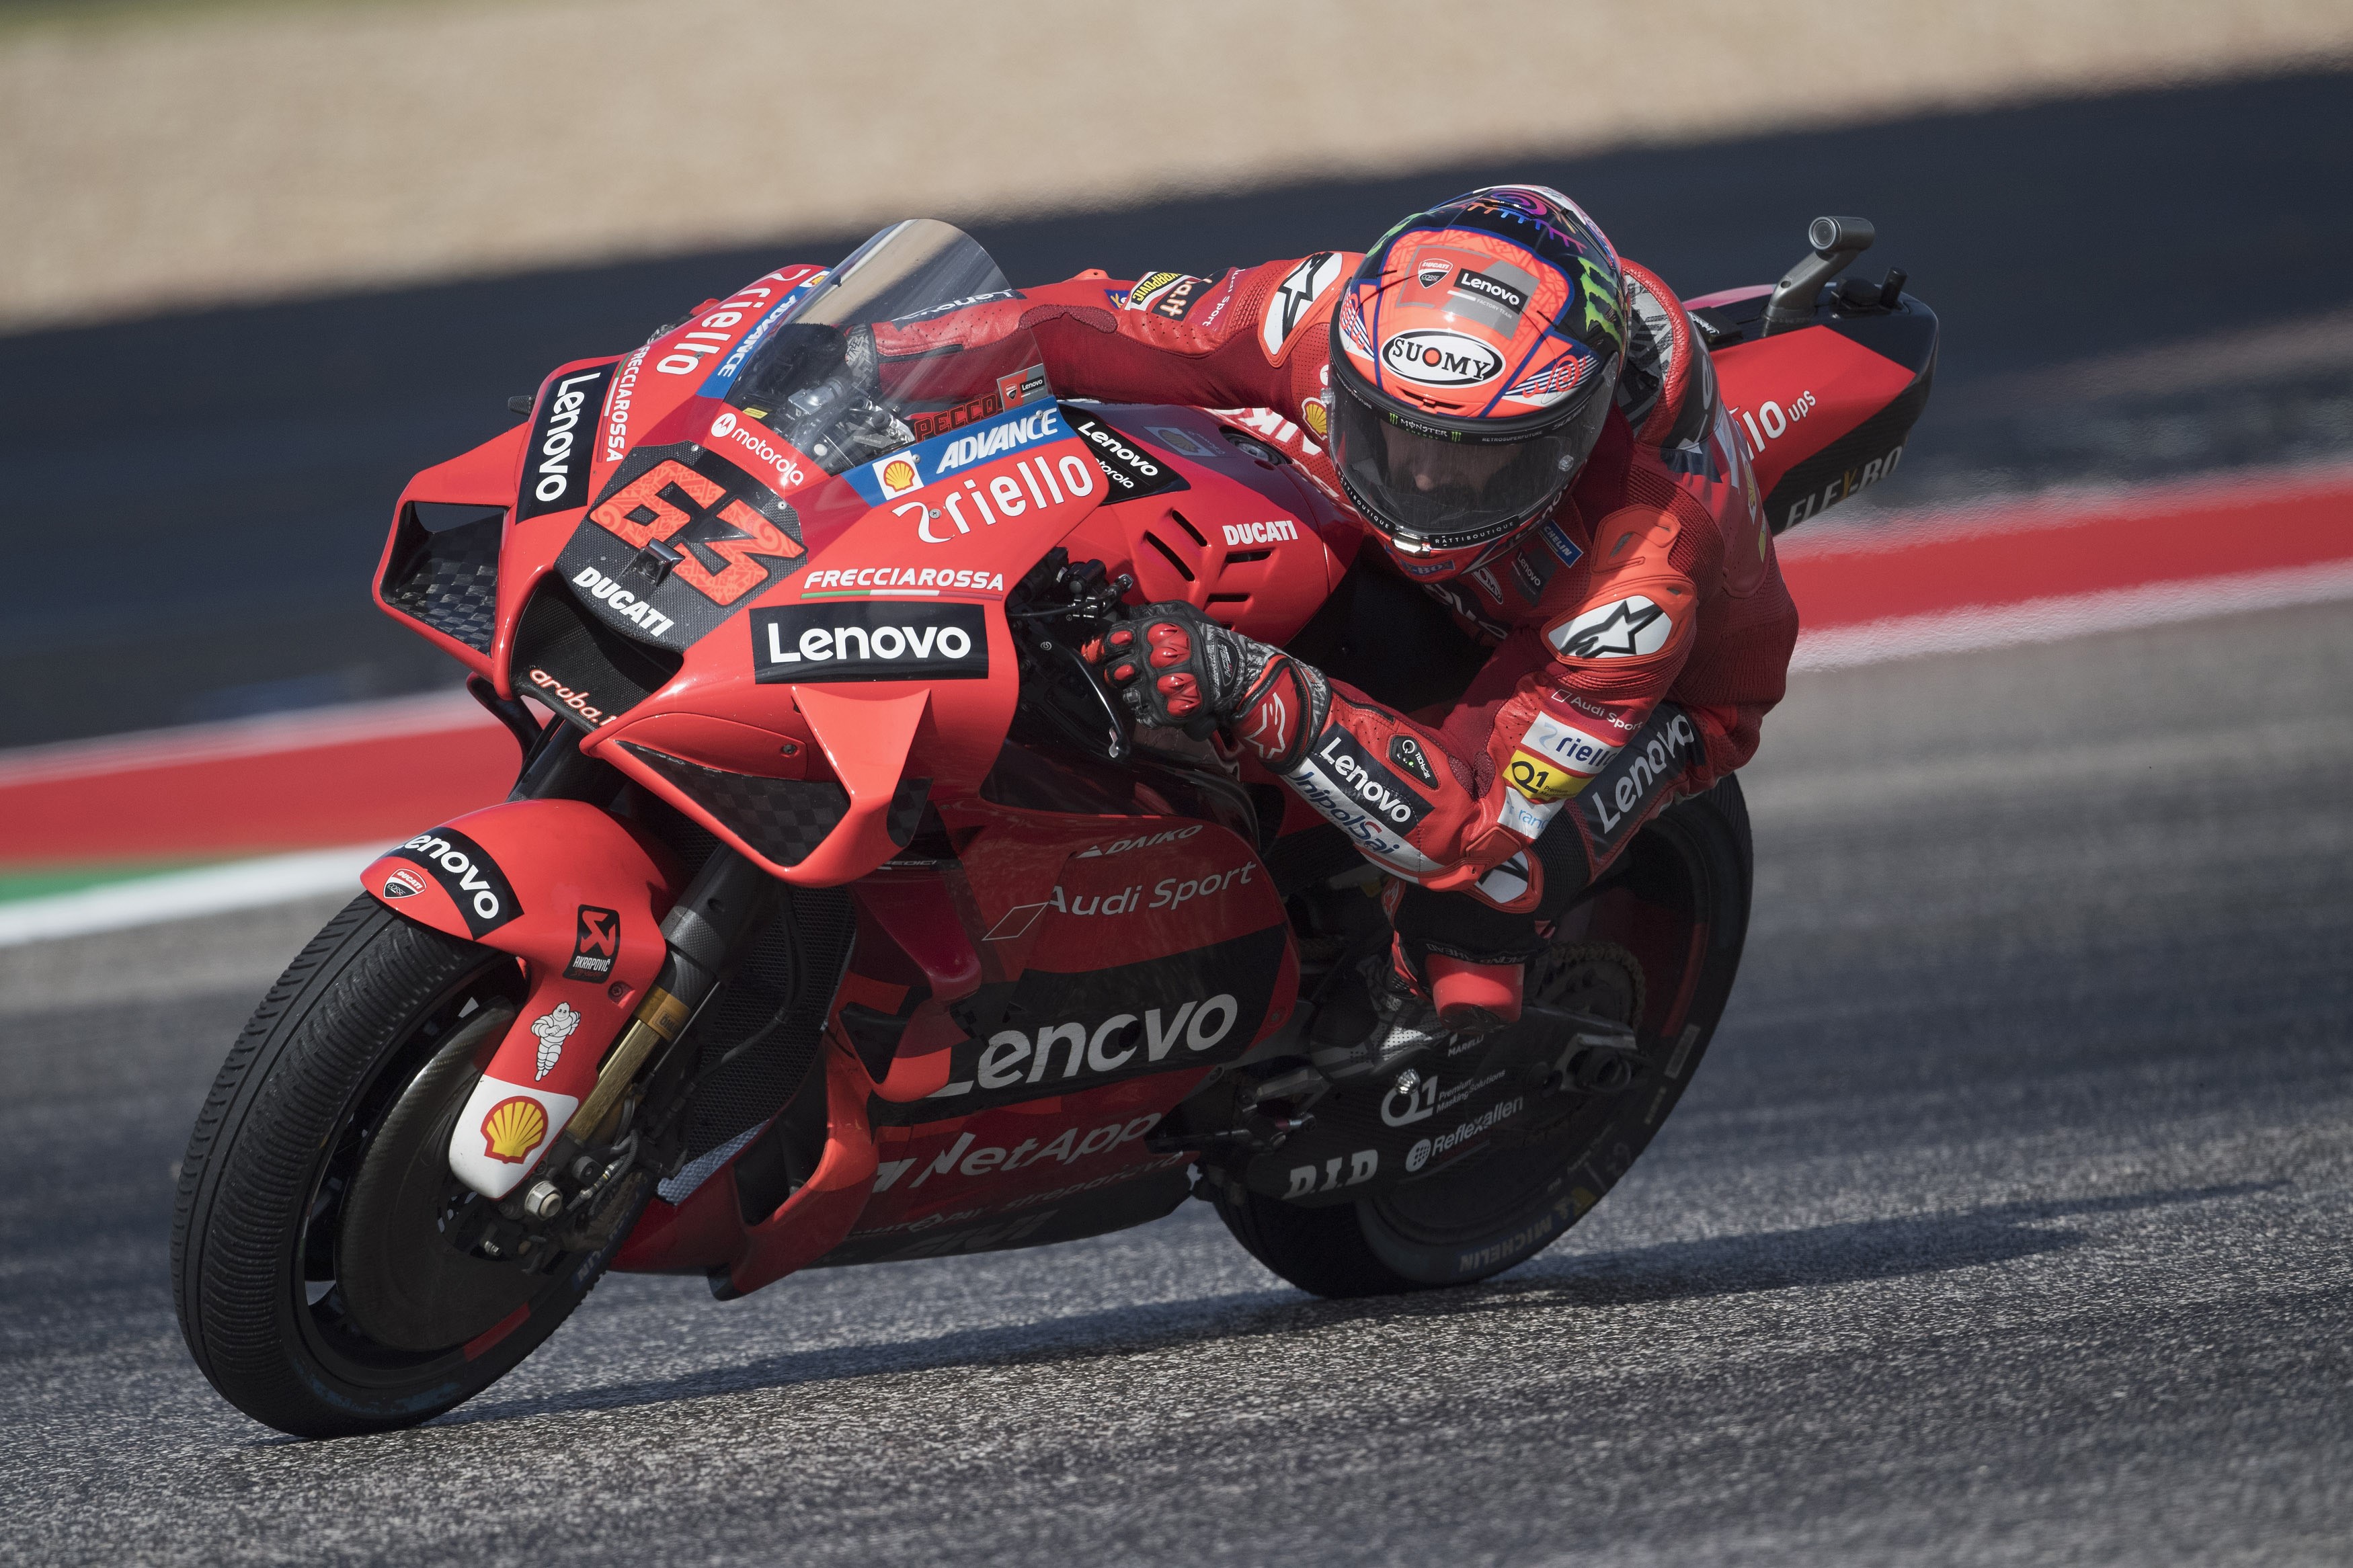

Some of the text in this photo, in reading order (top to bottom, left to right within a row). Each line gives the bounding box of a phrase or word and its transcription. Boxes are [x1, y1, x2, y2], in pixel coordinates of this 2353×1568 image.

[1203, 296, 1230, 327] Sport
[1461, 273, 1520, 305] Lenovo
[1476, 298, 1513, 319] FACTORY TEAM
[656, 288, 771, 375] riello
[717, 294, 796, 377] ADVANCE
[1390, 339, 1493, 380] SUOMY
[606, 345, 651, 462] FRECCIAROSSA
[1022, 378, 1043, 391] Lenovo
[1788, 390, 1816, 423] ups
[535, 372, 601, 501] Lenovo
[914, 393, 998, 442] PECCO
[936, 407, 1058, 474] ADVANCE
[1482, 430, 1543, 442] RETROSUPERFUTURE
[731, 426, 804, 486] motorola
[1078, 421, 1158, 476] Lenovo
[943, 455, 1094, 535] riello
[589, 460, 806, 607] 63
[1222, 520, 1298, 546] DUCATI
[1544, 526, 1572, 556] CHELIN
[805, 568, 1004, 591] FRECCIAROSSA
[1518, 553, 1541, 586] Lenovo
[573, 566, 674, 637] DUCATI
[768, 623, 971, 663] Lenovo
[529, 667, 618, 727] aruba.i
[1570, 696, 1643, 731] Audi Sport
[1320, 737, 1411, 823] Lenovo
[1511, 761, 1550, 794] Q1
[1592, 714, 1694, 834] Lenovo
[388, 883, 405, 895] CORSE
[397, 870, 423, 889] DUCATI
[403, 835, 499, 919] enovo
[1047, 860, 1257, 915] Audi Sport
[1447, 1034, 1484, 1057] MARELLI
[1437, 1069, 1506, 1114] Masking Solutions
[909, 1112, 1164, 1189] NetApp
[1432, 1096, 1523, 1157] Reflexallen
[1459, 1214, 1552, 1272] MICHELIN
